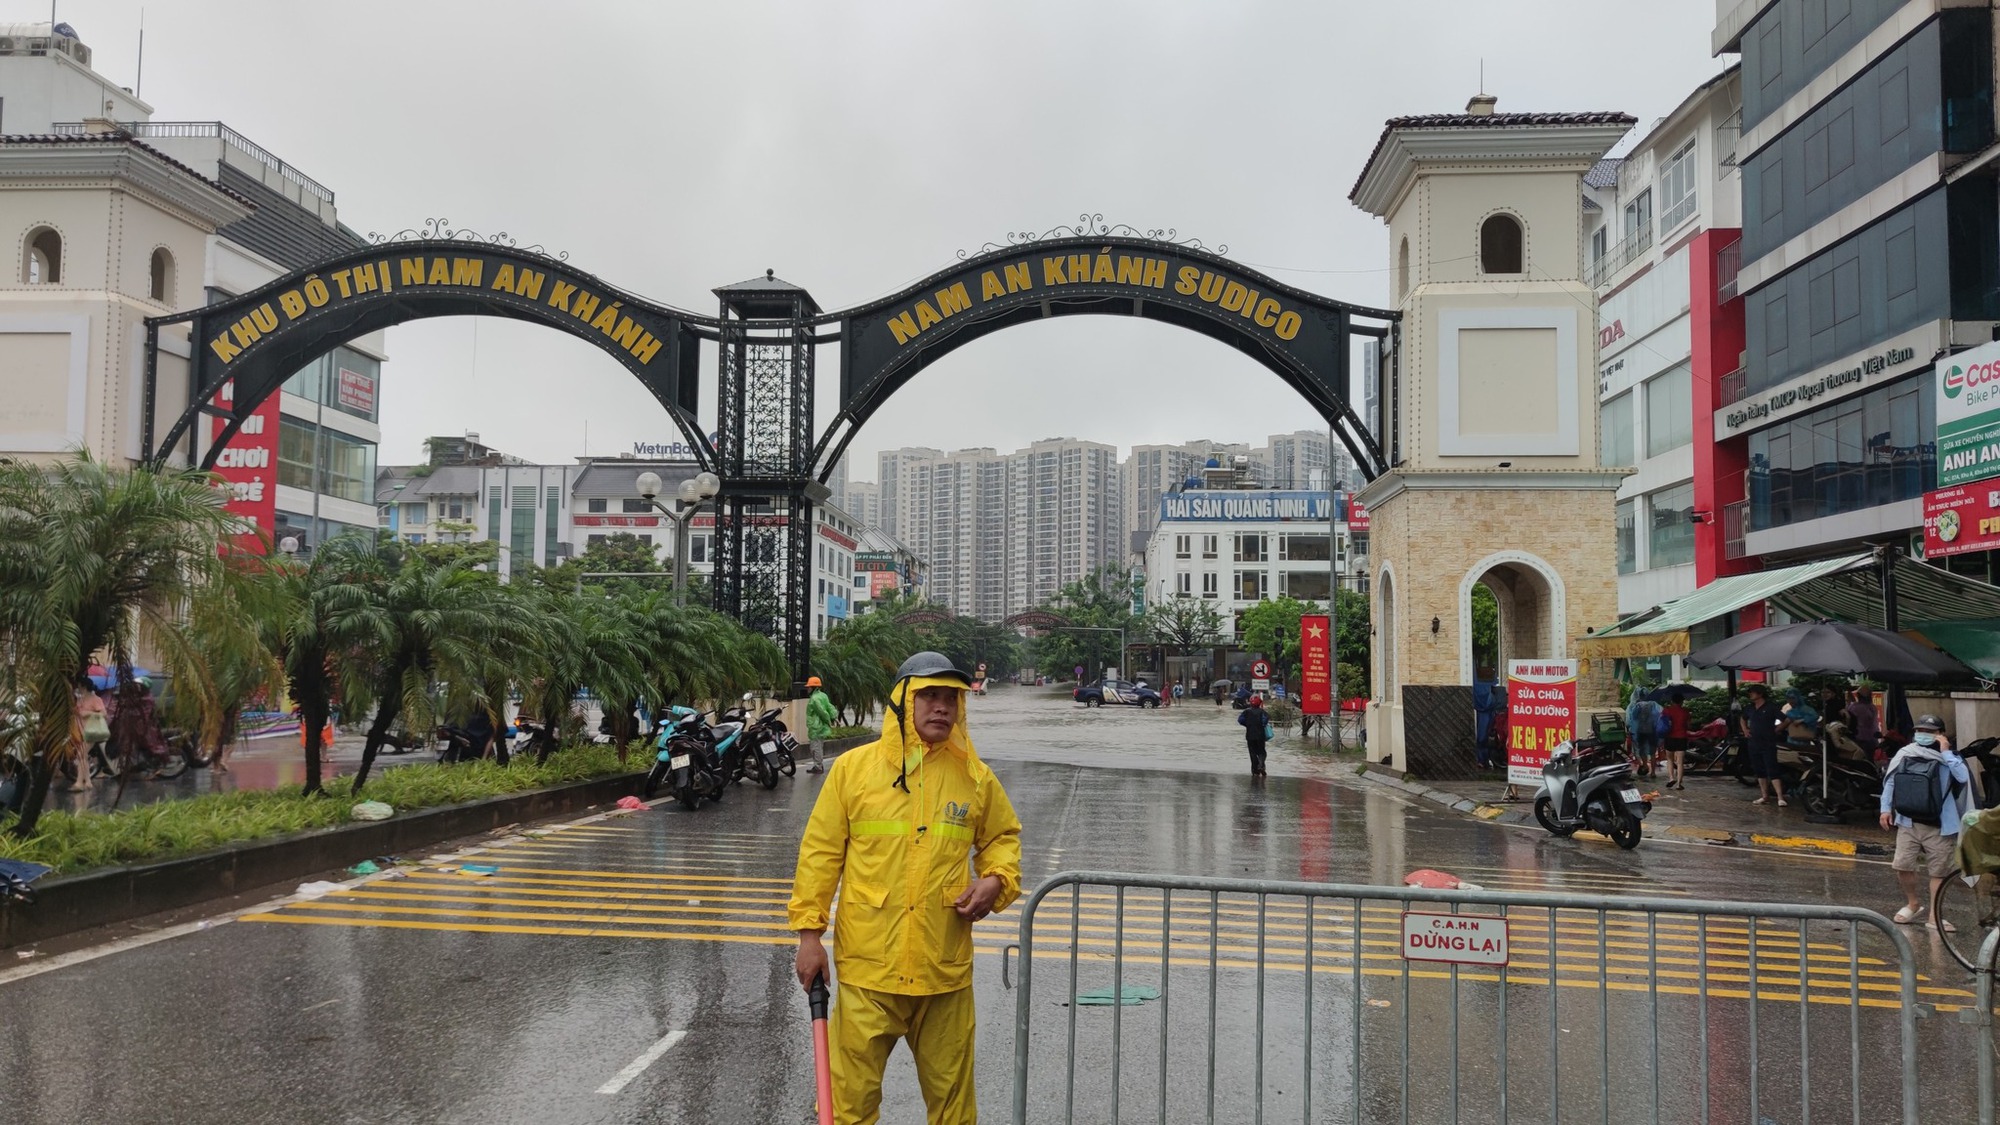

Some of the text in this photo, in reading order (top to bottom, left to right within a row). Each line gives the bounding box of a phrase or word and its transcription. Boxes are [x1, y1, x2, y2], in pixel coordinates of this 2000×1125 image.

[886, 246, 1302, 345] NAM AN KHÁNH SUDICO
[209, 257, 662, 365] KHU ĐÔ THỊ NAM AN KHÁNH
[1768, 391, 1797, 411] TMCP
[1862, 355, 1885, 375] Việt
[1886, 347, 1914, 367] Nam
[1967, 390, 1988, 406] Bike
[634, 442, 692, 454] VietinBa
[1955, 439, 1962, 447] XE
[216, 446, 269, 468] CHƠI
[1943, 442, 2000, 472] ANH AN
[1167, 493, 1190, 518] HẢI
[1193, 493, 1221, 518] SẢN
[1224, 493, 1271, 519] QUẢNG
[1274, 499, 1308, 518] NINH
[1989, 491, 2000, 508] B
[1929, 528, 1936, 537] 12
[867, 562, 887, 570] CITY
[1515, 665, 1569, 676] ANH ANH MOTOR
[1518, 686, 1564, 700] SỬA CHỮA
[1513, 702, 1570, 717] BẢO DƯỠNG
[1512, 726, 1523, 749] XE
[1525, 727, 1537, 750] GA
[1545, 728, 1556, 751] XE
[1511, 754, 1524, 763] RỬA
[1525, 756, 1534, 764] XE
[1432, 919, 1479, 931] C.A.H.N
[1410, 930, 1501, 955] DỪNG LẠI
